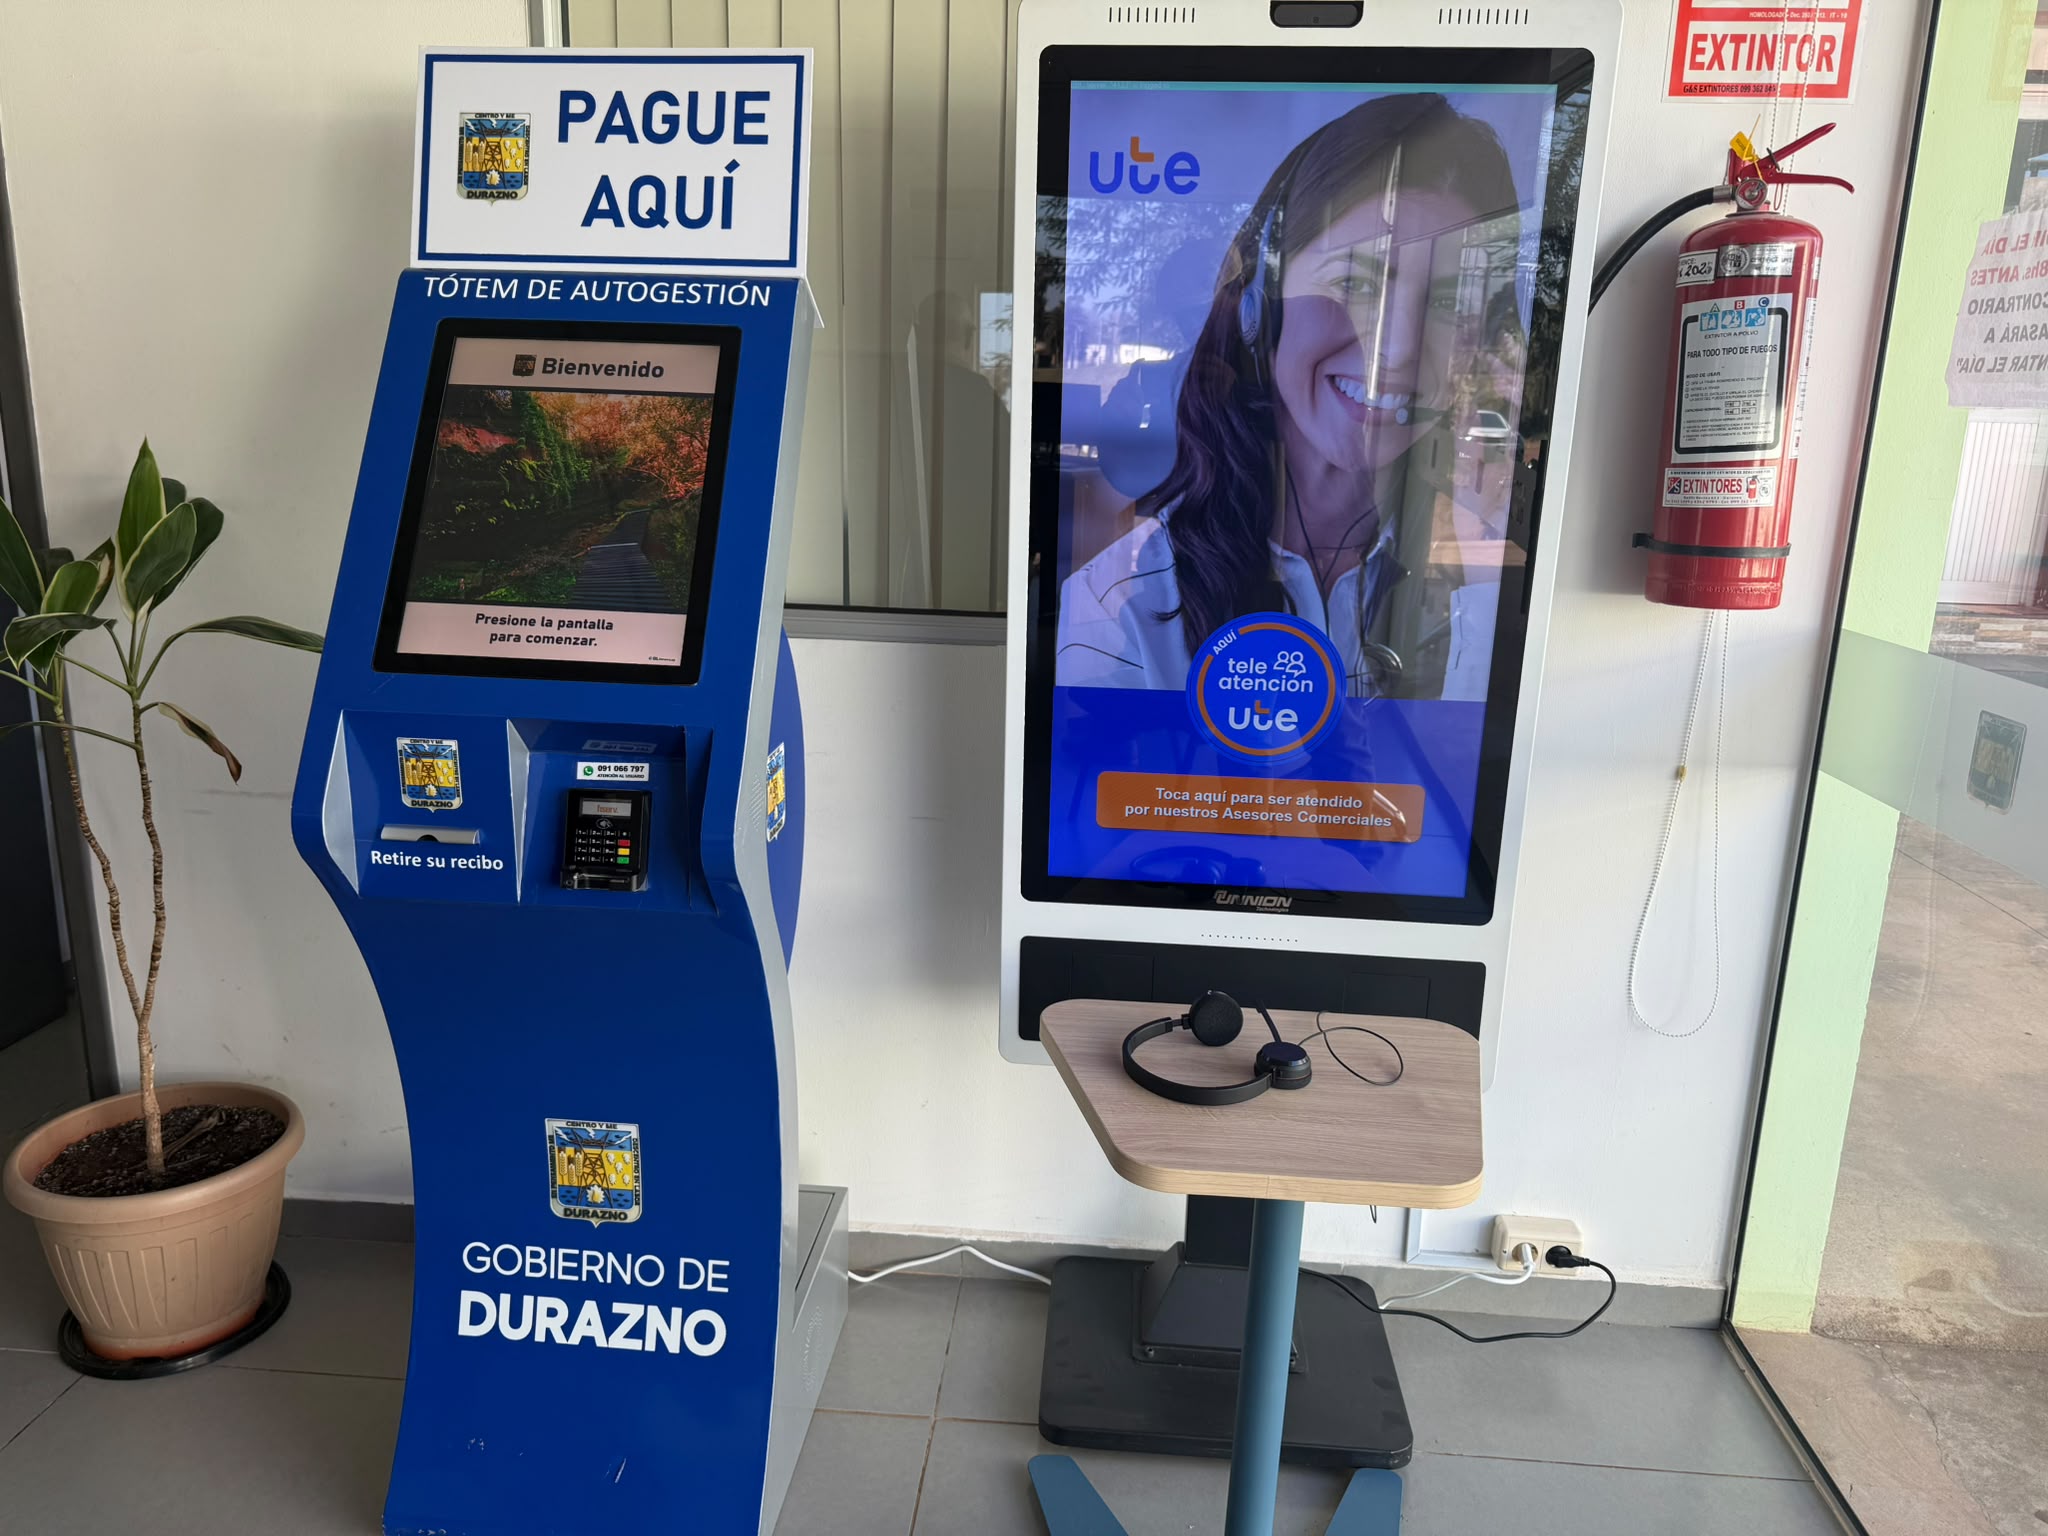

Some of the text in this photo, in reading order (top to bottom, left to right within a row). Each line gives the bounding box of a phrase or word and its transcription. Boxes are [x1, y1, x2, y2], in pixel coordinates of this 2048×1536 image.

[1688, 33, 1836, 72] EXTINTOR
[1699, 85, 1738, 93] EXTINTORES
[558, 90, 770, 145] PAGUE
[1089, 136, 1200, 195] ute
[466, 191, 518, 200] DURAZNO
[580, 159, 740, 229] AQUÍ
[423, 273, 771, 307] TÓTEM DE AUTOGESTIÓN
[1704, 332, 1732, 340] EXTINTOR
[1687, 344, 1778, 359] PARA TODO TIPO DE FUEGOS
[541, 358, 665, 379] Bienvenido
[1683, 478, 1742, 493] EXTINTORES
[475, 613, 614, 634] Presione la pantalla
[489, 632, 598, 647] para comenzar.
[1212, 629, 1238, 655] AQUÍ
[1228, 657, 1268, 674] tele
[1228, 700, 1299, 732] ute
[411, 800, 453, 808] DURAZNO
[1156, 787, 1363, 809] Toca aquí para ser atendido
[1125, 804, 1392, 827] por nuestros Asesores Comerciales
[371, 850, 504, 870] Retire su recibo
[566, 1120, 597, 1128] CENTRO
[563, 1208, 628, 1221] DURAZNO
[462, 1241, 730, 1292] GOBIERNO DE
[458, 1289, 727, 1357] DURAZNO
